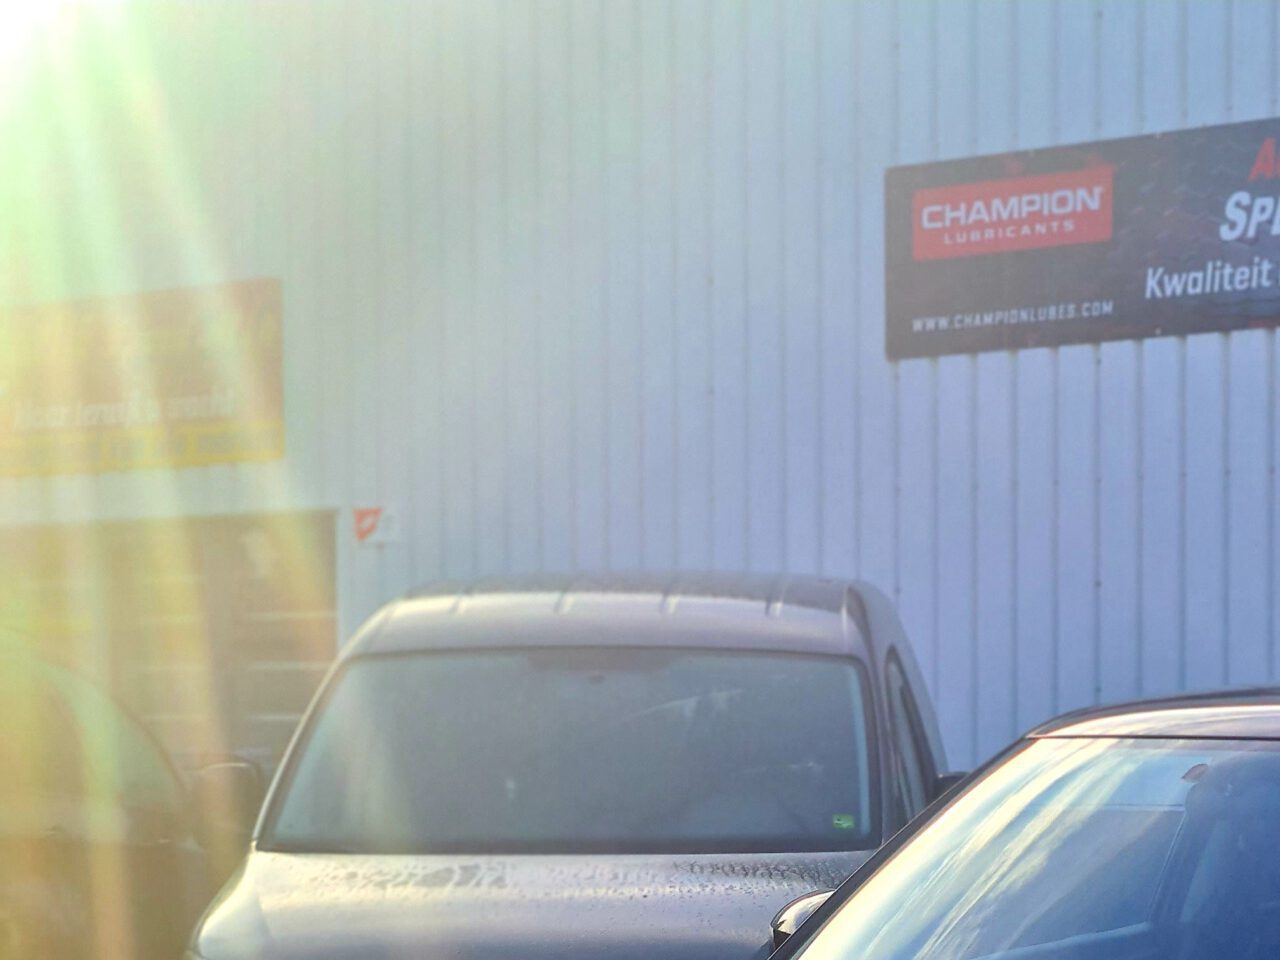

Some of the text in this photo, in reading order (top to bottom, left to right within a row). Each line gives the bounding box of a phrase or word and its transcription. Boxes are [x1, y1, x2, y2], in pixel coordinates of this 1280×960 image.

[921, 187, 1101, 229] CHAMPION
[944, 219, 1075, 244] LUBRICANTS
[1145, 256, 1271, 299] Kwaliteit
[912, 300, 1115, 333] WWW.CHAMPIONLUBES.COM
